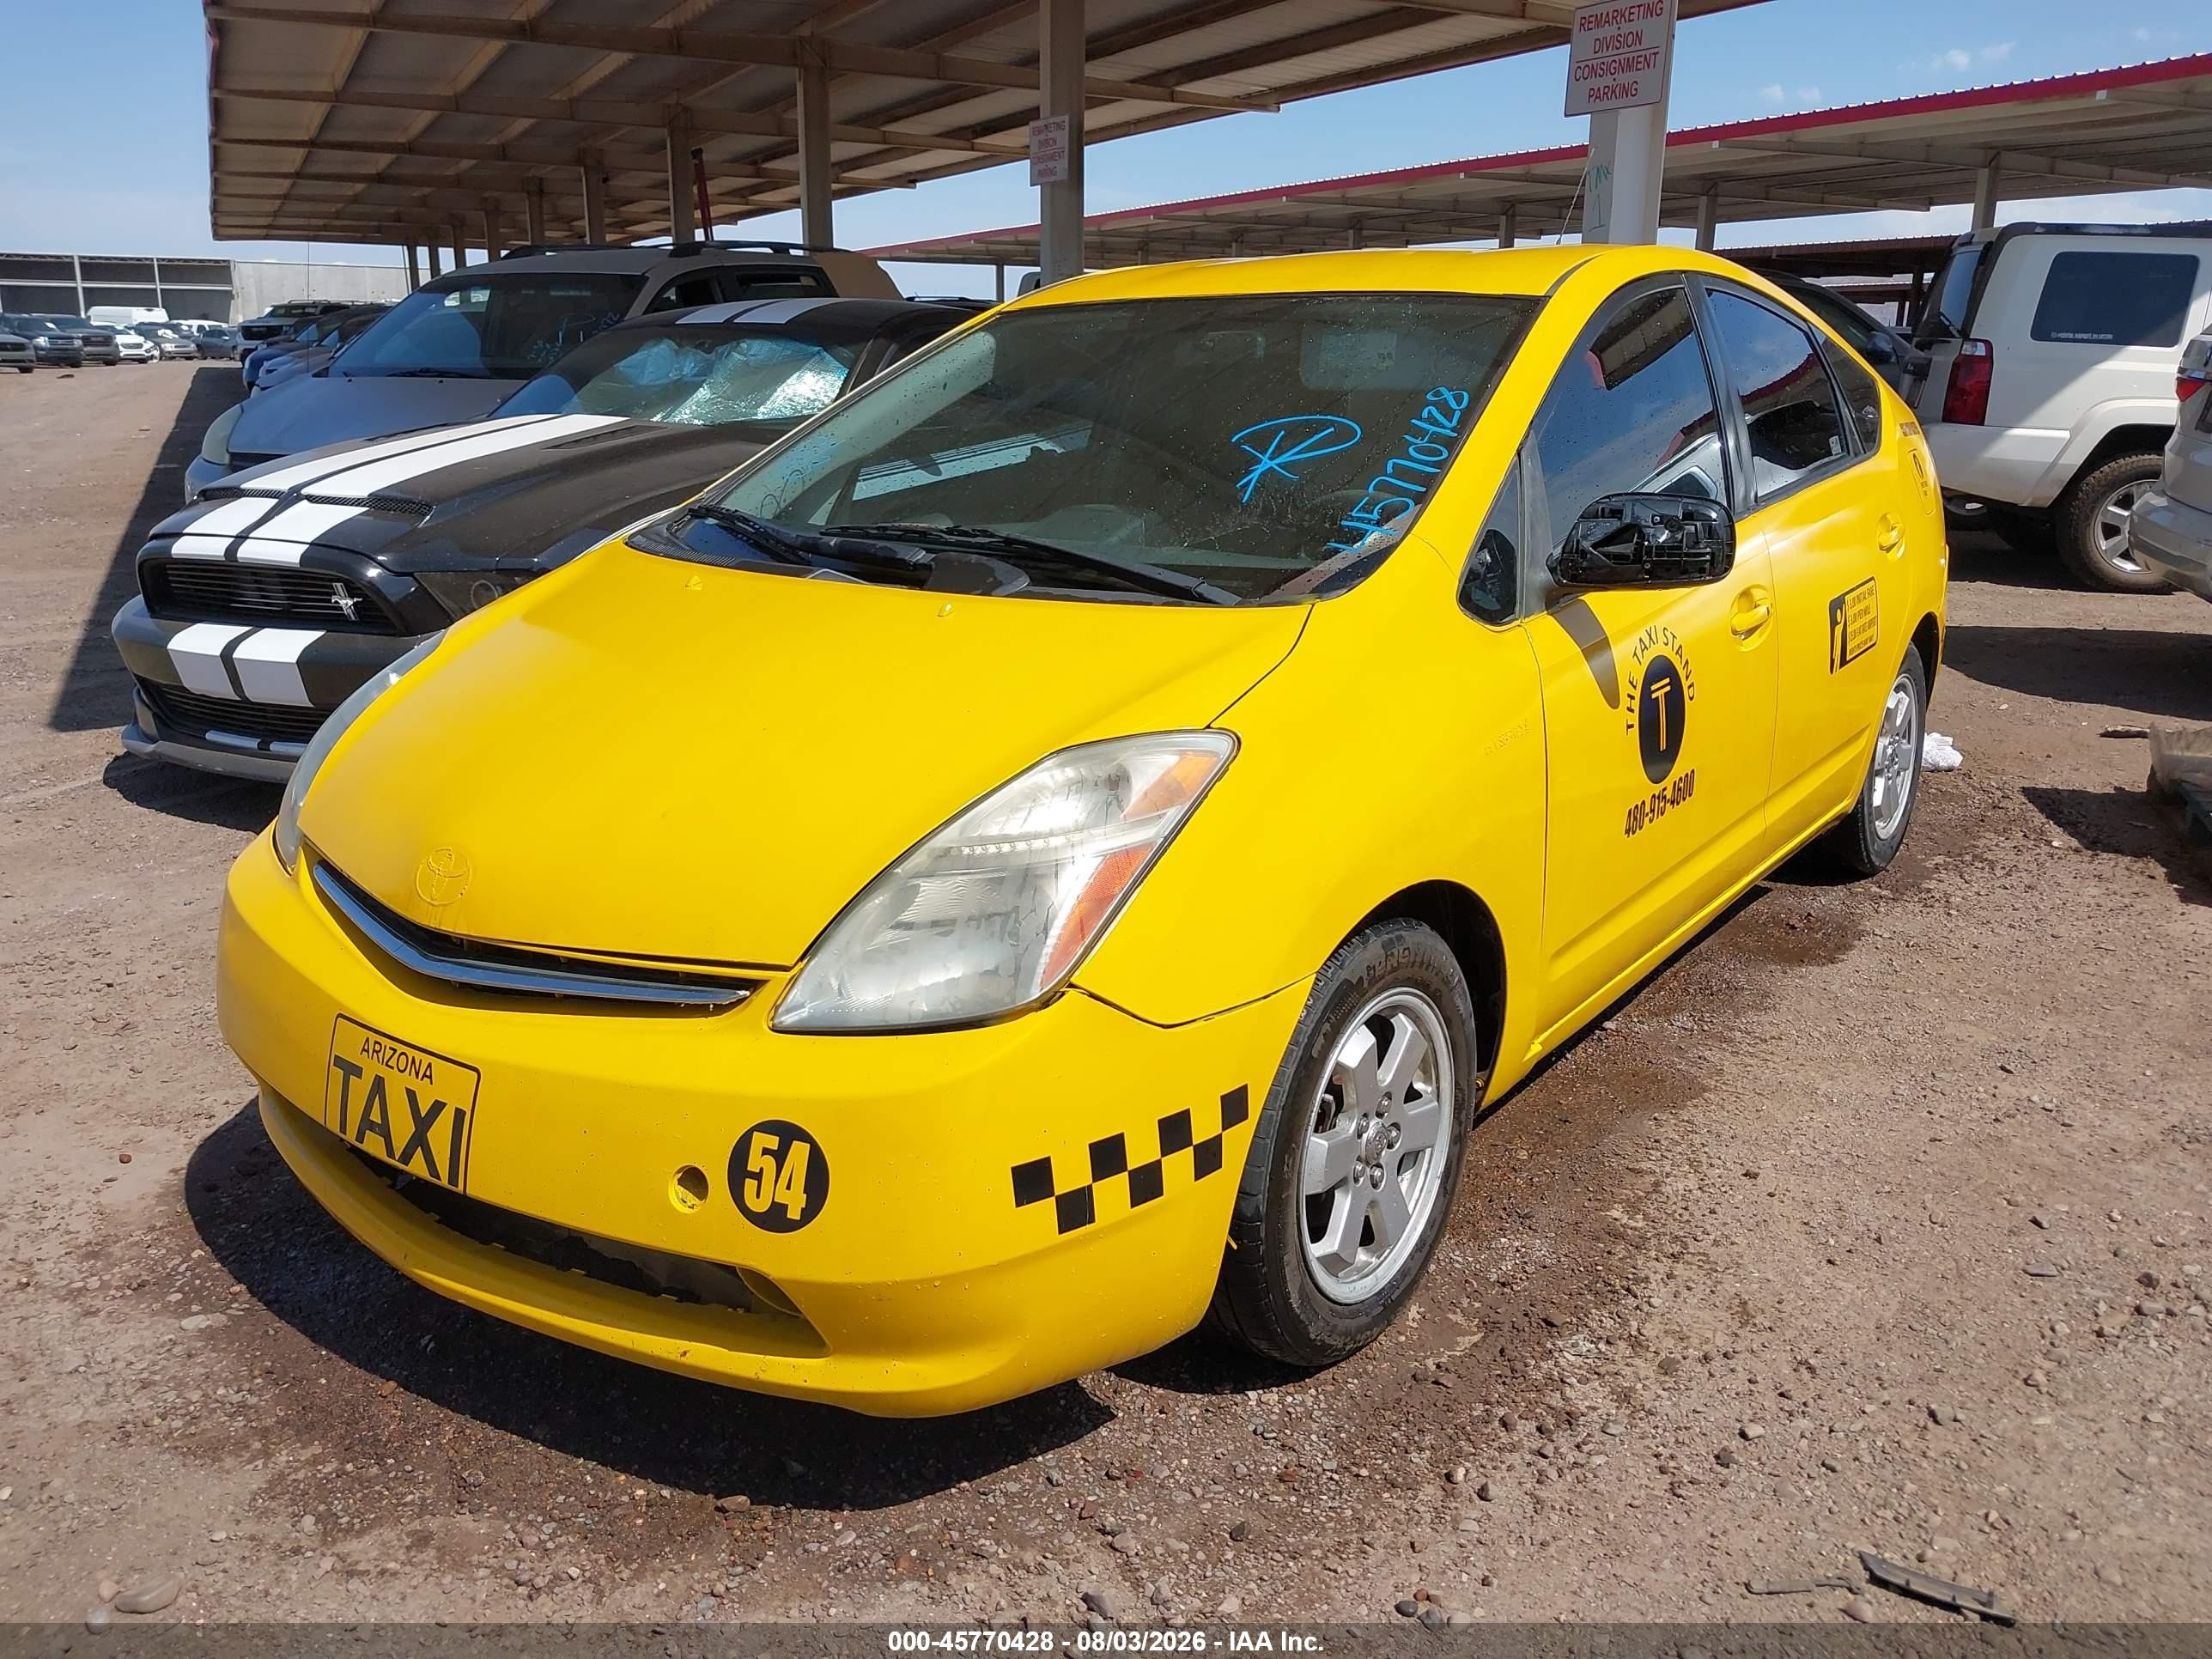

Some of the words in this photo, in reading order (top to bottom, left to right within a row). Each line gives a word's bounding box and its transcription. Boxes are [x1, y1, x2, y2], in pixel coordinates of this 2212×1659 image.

[1579, 0, 1664, 33] REMARKETING
[1593, 29, 1644, 54] DIVISION
[1574, 52, 1660, 82] CONSIGNMENT
[1588, 81, 1638, 103] PARKING
[1325, 386, 1470, 552] 45770428
[1626, 671, 1638, 736] THE
[1632, 625, 1659, 666] TAXI
[1662, 627, 1696, 702] STAND
[1625, 769, 1696, 838] 480-915-4600
[360, 1036, 434, 1085] ARIZONA
[332, 1054, 467, 1188] TAXI
[744, 1131, 811, 1220] 54
